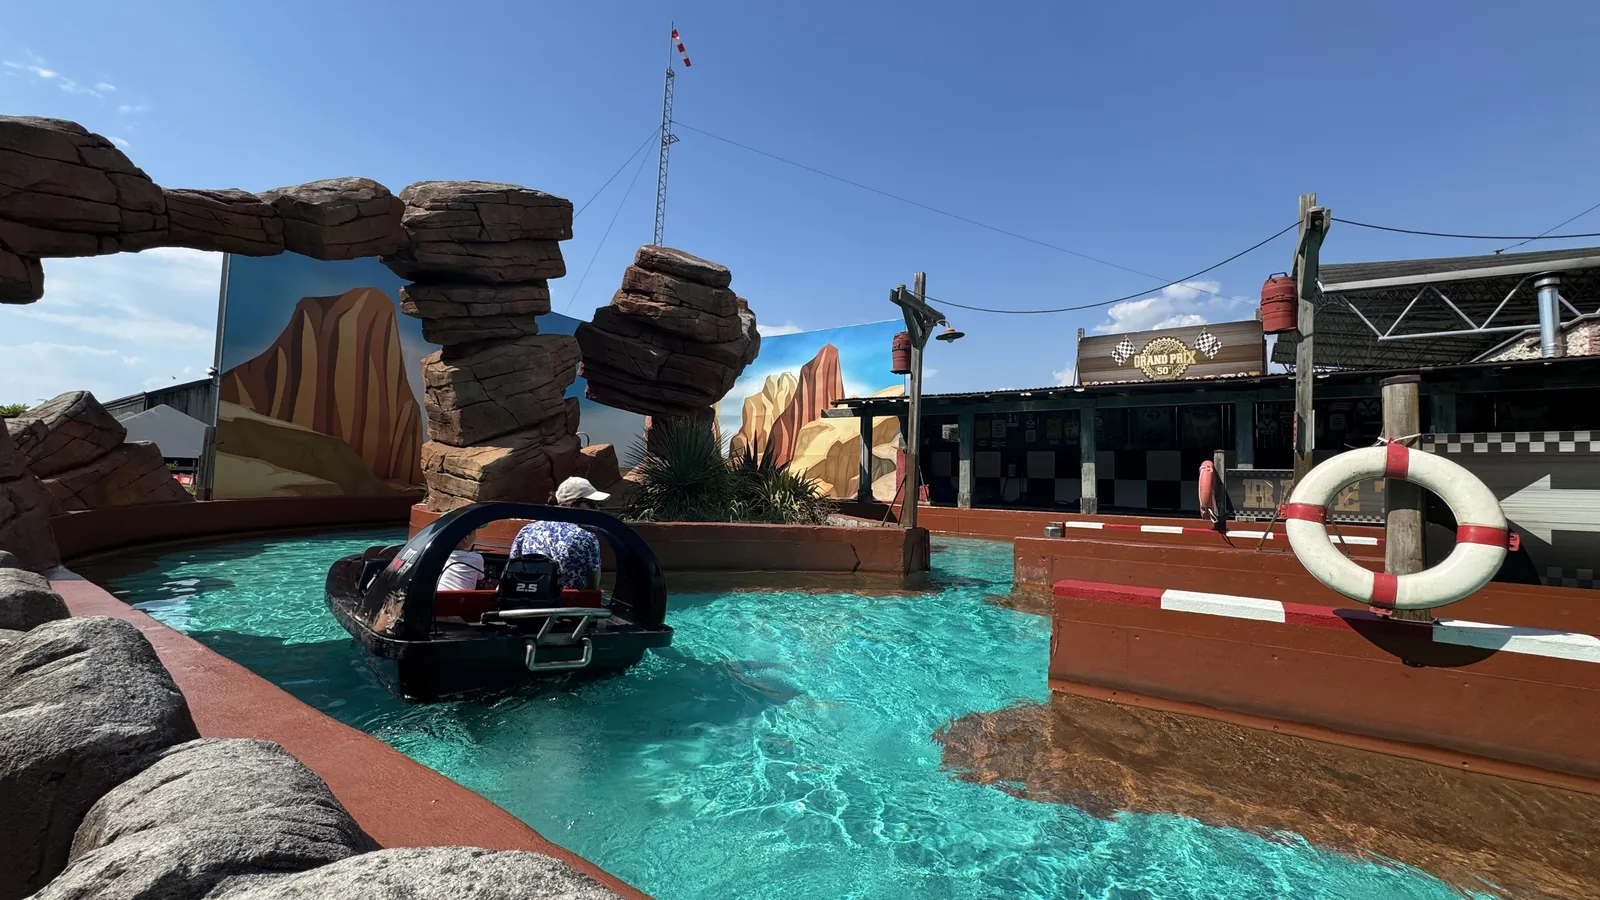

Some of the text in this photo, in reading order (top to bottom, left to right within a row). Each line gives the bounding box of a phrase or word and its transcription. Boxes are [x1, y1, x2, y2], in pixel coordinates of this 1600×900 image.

[1134, 350, 1196, 368] GRAND PRIX
[516, 583, 538, 592] 2.5
